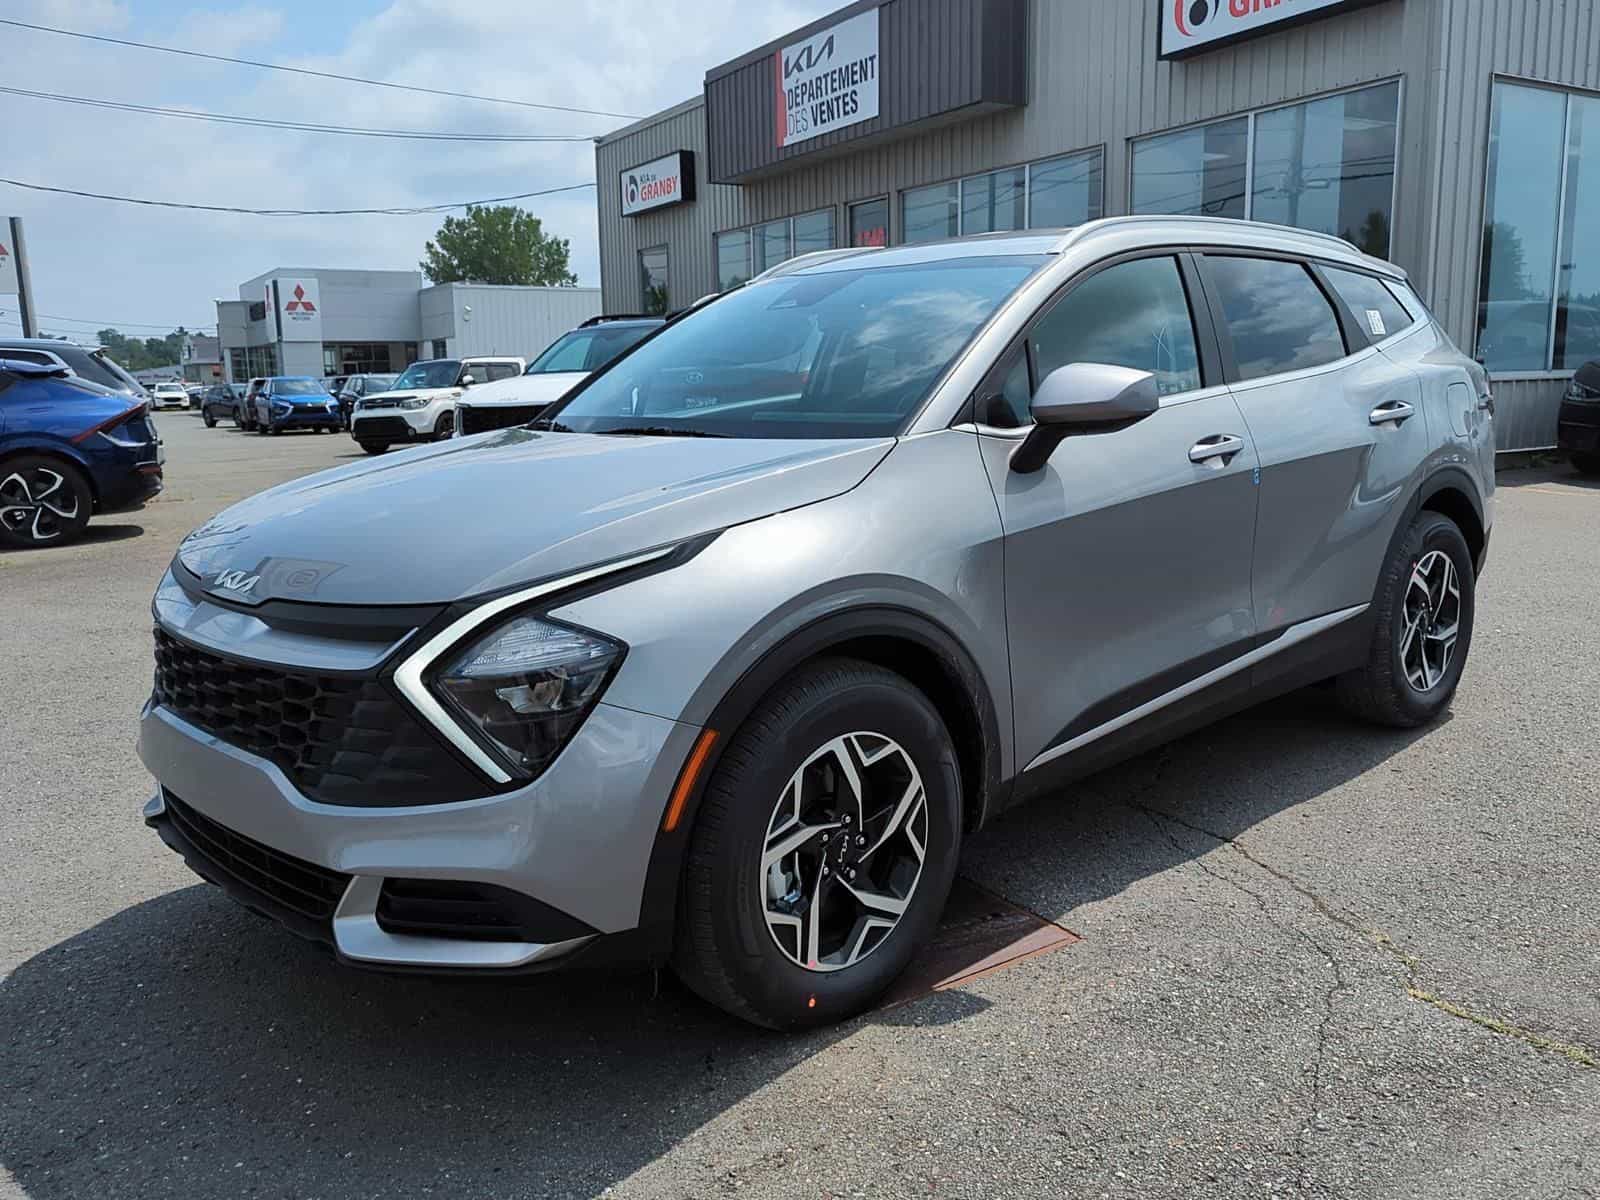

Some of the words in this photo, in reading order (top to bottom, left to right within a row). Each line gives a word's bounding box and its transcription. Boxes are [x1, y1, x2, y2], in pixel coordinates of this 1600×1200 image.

[783, 33, 834, 80] KIA
[787, 54, 877, 111] DÉPARTEMENT
[788, 108, 809, 136] DES
[810, 89, 858, 127] VENTES
[641, 175, 678, 202] GRANBY
[214, 567, 261, 593] KIA
